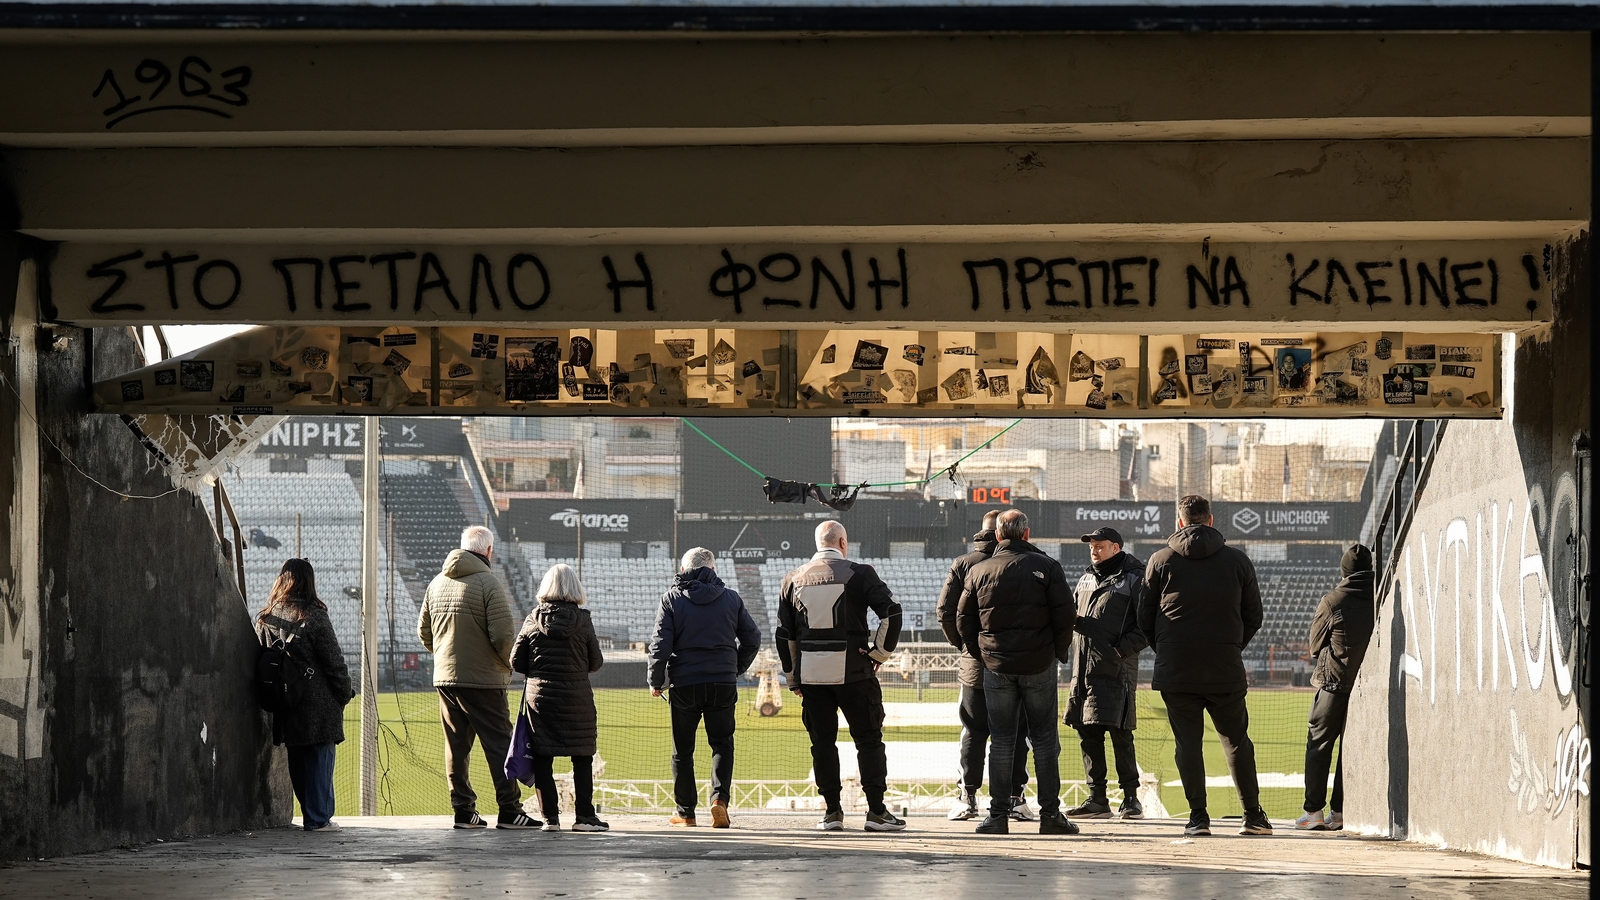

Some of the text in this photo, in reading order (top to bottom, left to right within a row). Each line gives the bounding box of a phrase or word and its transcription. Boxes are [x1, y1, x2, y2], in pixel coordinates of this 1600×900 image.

[92, 56, 253, 115] 1963
[86, 250, 242, 313] ΣΤΟ
[272, 251, 551, 315] ΠΕΤΑΛΟ
[602, 250, 655, 313] Η
[709, 248, 909, 314] ΦΩΝΗ
[963, 256, 1160, 311] ΠΡΕΠΕΙ
[1186, 254, 1251, 309] ΝΑ
[1440, 347, 1481, 355] BIANCO
[972, 487, 987, 504] 10
[1075, 507, 1142, 521] freenow
[1265, 510, 1330, 525] LUNCHBOX
[1143, 523, 1160, 535] lyft
[766, 550, 781, 558] 360
